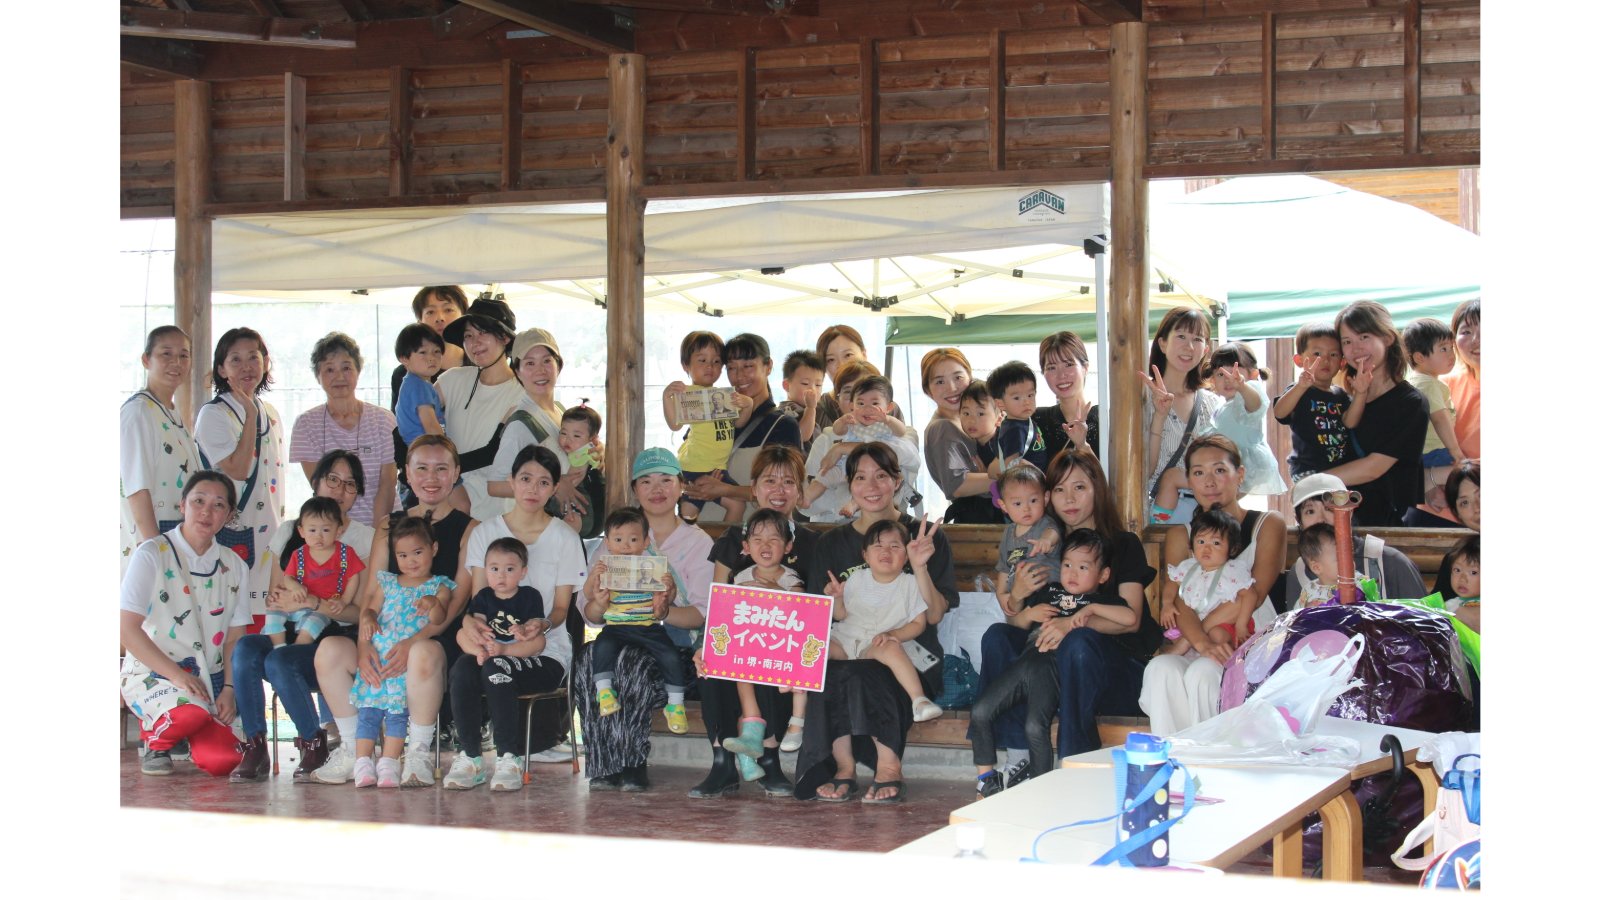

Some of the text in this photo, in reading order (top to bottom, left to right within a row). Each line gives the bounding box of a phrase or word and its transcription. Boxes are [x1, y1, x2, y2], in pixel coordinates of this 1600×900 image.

[1020, 191, 1065, 212] CARAVAN
[716, 430, 727, 441] AS
[733, 601, 805, 632] まみたん
[733, 629, 800, 653] イベント
[733, 655, 793, 673] in 堺・南河内
[144, 687, 178, 704] WHERE'S
